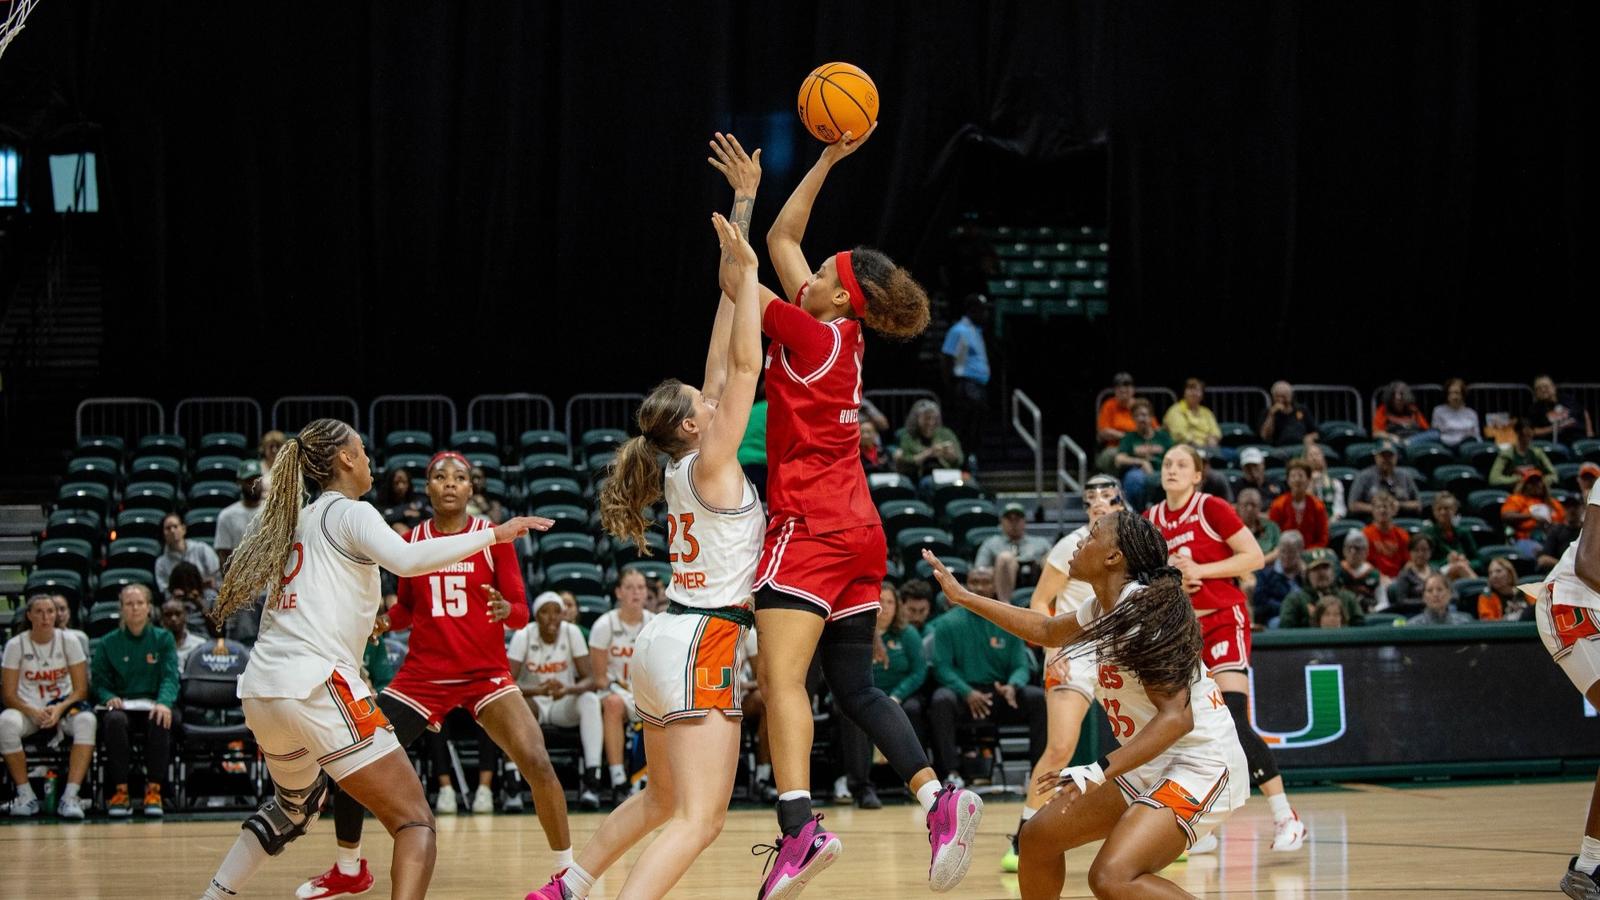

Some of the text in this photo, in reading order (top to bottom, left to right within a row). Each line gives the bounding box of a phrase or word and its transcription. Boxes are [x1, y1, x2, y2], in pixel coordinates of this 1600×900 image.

[428, 575, 469, 618] 15
[24, 668, 67, 681] CANES
[695, 666, 732, 690] U
[1247, 664, 1346, 749] U
